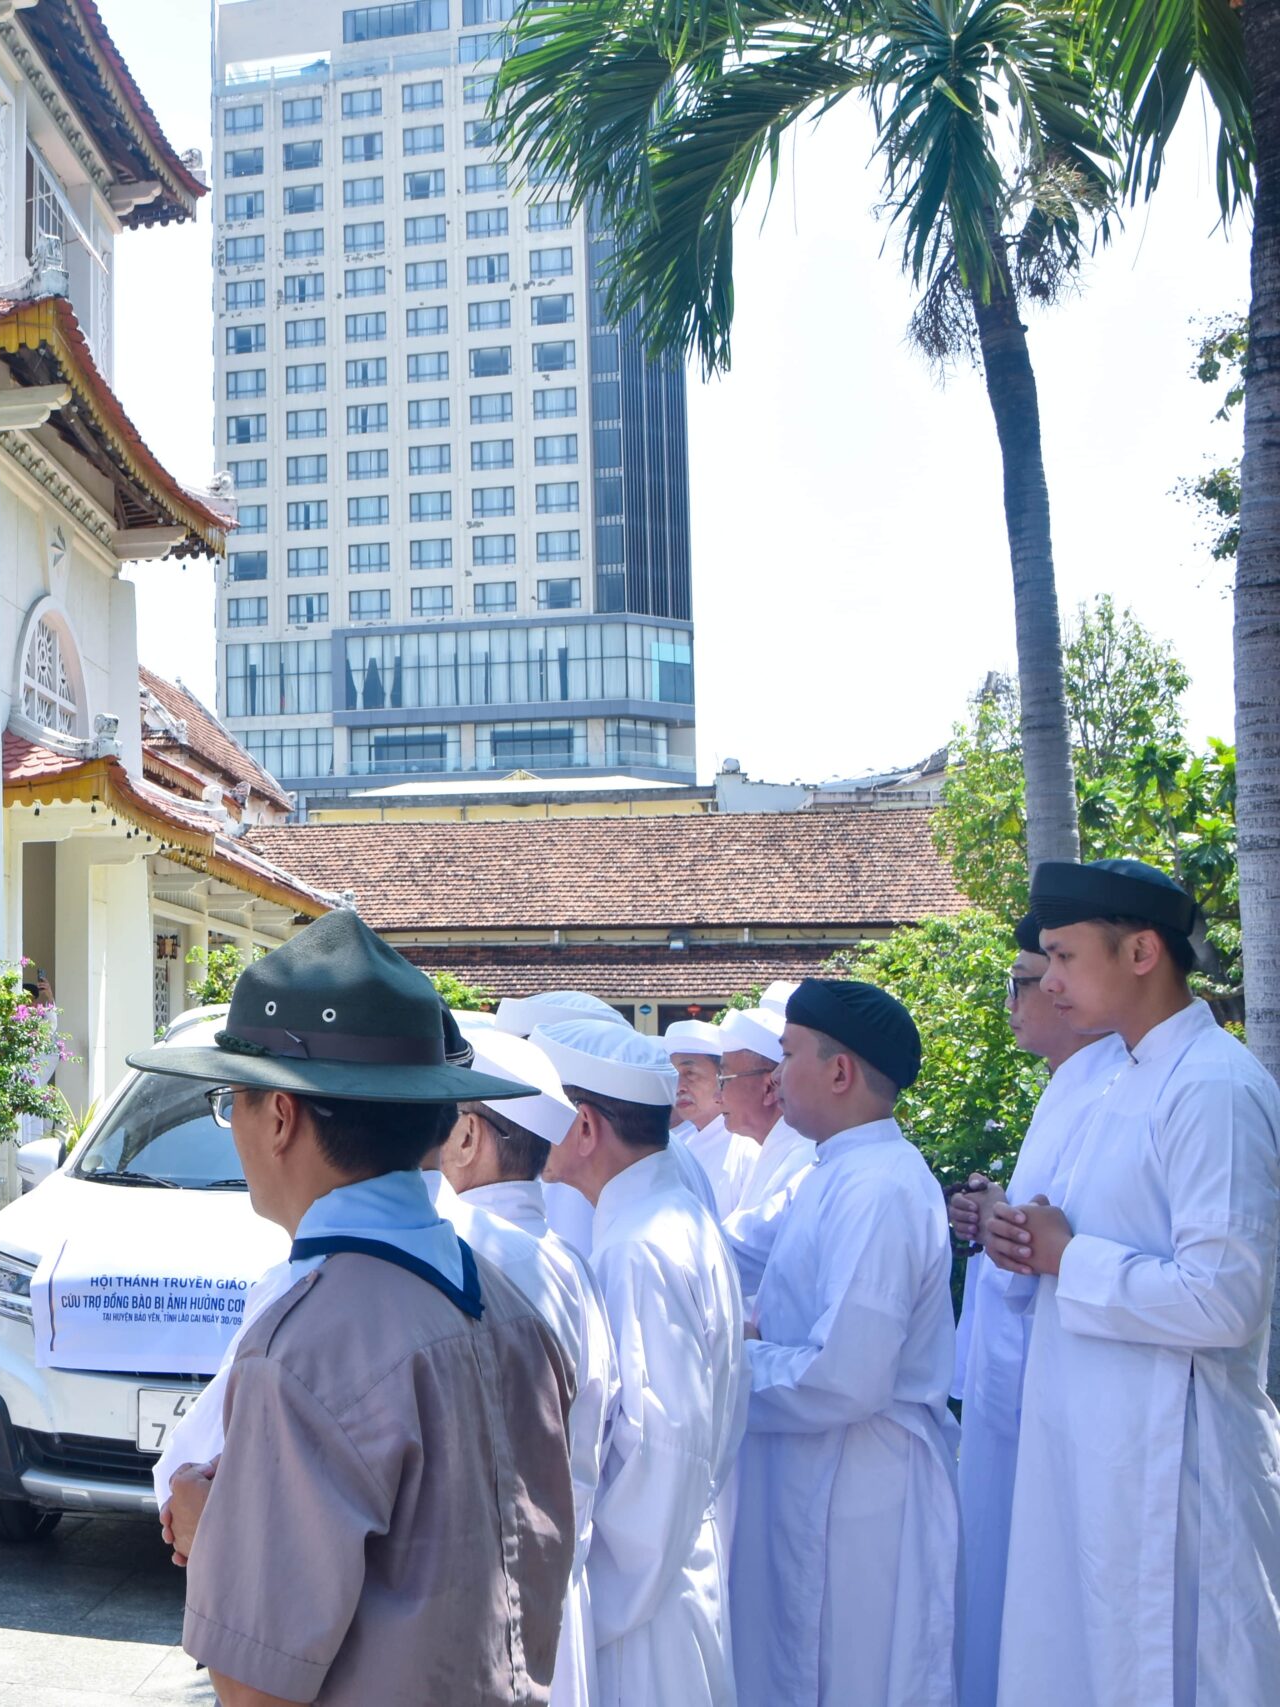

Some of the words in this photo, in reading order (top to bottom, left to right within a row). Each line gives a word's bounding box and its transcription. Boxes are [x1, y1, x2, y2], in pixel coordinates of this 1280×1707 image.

[90, 1274, 112, 1290] HỘI
[116, 1273, 159, 1288] THÁNH
[163, 1275, 213, 1289] TRUYỀN
[216, 1277, 247, 1291] GIÁO
[83, 1294, 102, 1311] TRỢ
[131, 1293, 151, 1309] BÀO
[154, 1295, 165, 1312] BỊ
[167, 1293, 187, 1309] ẢNH
[190, 1293, 225, 1311] HƯỞNG
